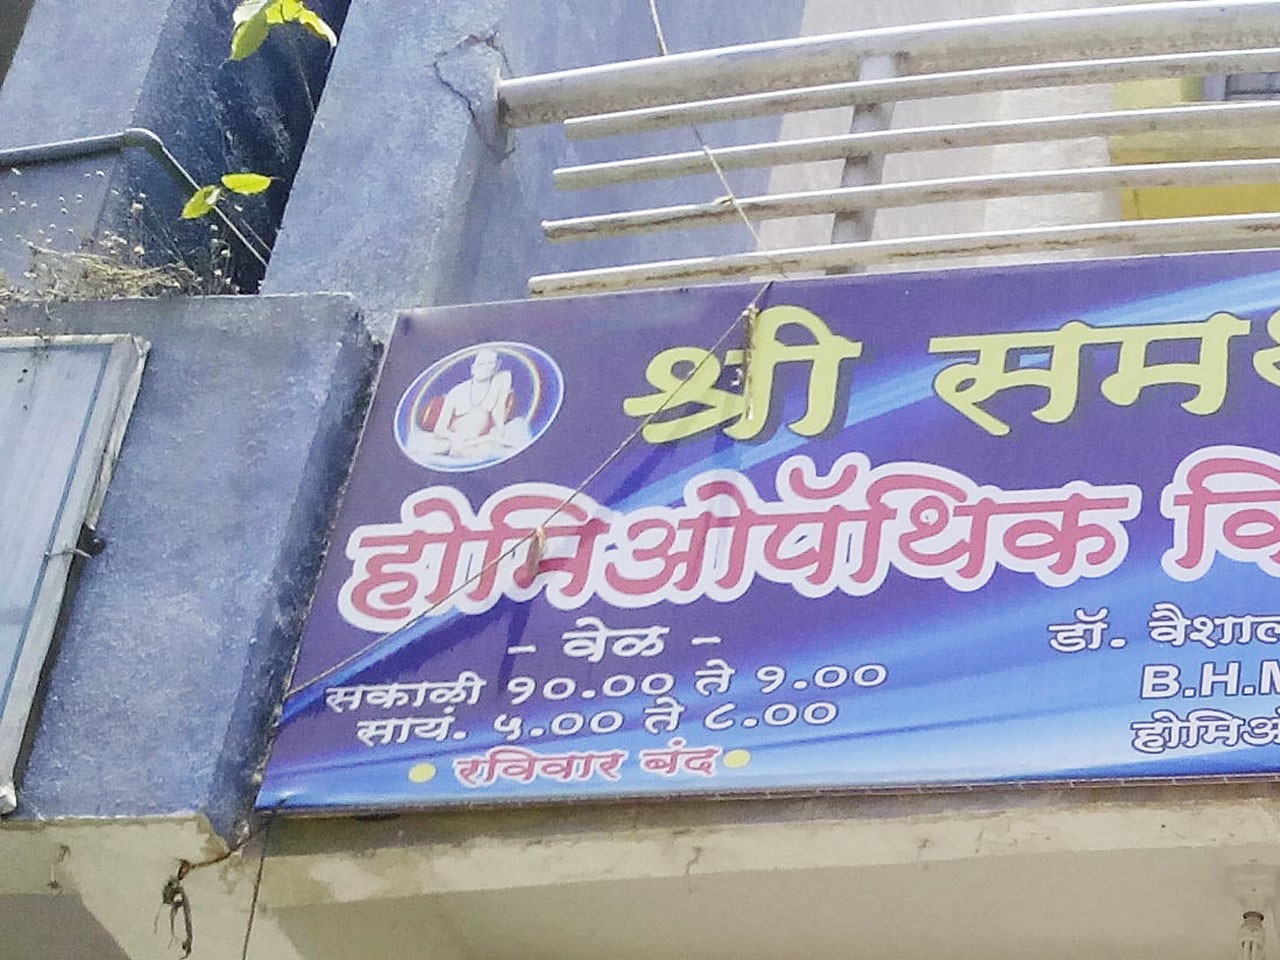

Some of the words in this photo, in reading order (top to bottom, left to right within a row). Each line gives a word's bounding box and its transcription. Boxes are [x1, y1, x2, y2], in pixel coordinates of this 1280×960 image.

[622, 305, 862, 443] श्री
[338, 452, 1142, 633] होमिओपॅथिक
[562, 617, 670, 662] वेळ
[1048, 606, 1127, 653] डॉ.
[326, 671, 487, 713] सकाळी
[695, 659, 735, 695] ते
[357, 705, 467, 747] सायं.
[493, 710, 624, 740] ५.००
[644, 697, 685, 734] ते
[704, 701, 838, 730] ८.००
[453, 746, 627, 787] रविवार
[640, 737, 722, 778] बंद
